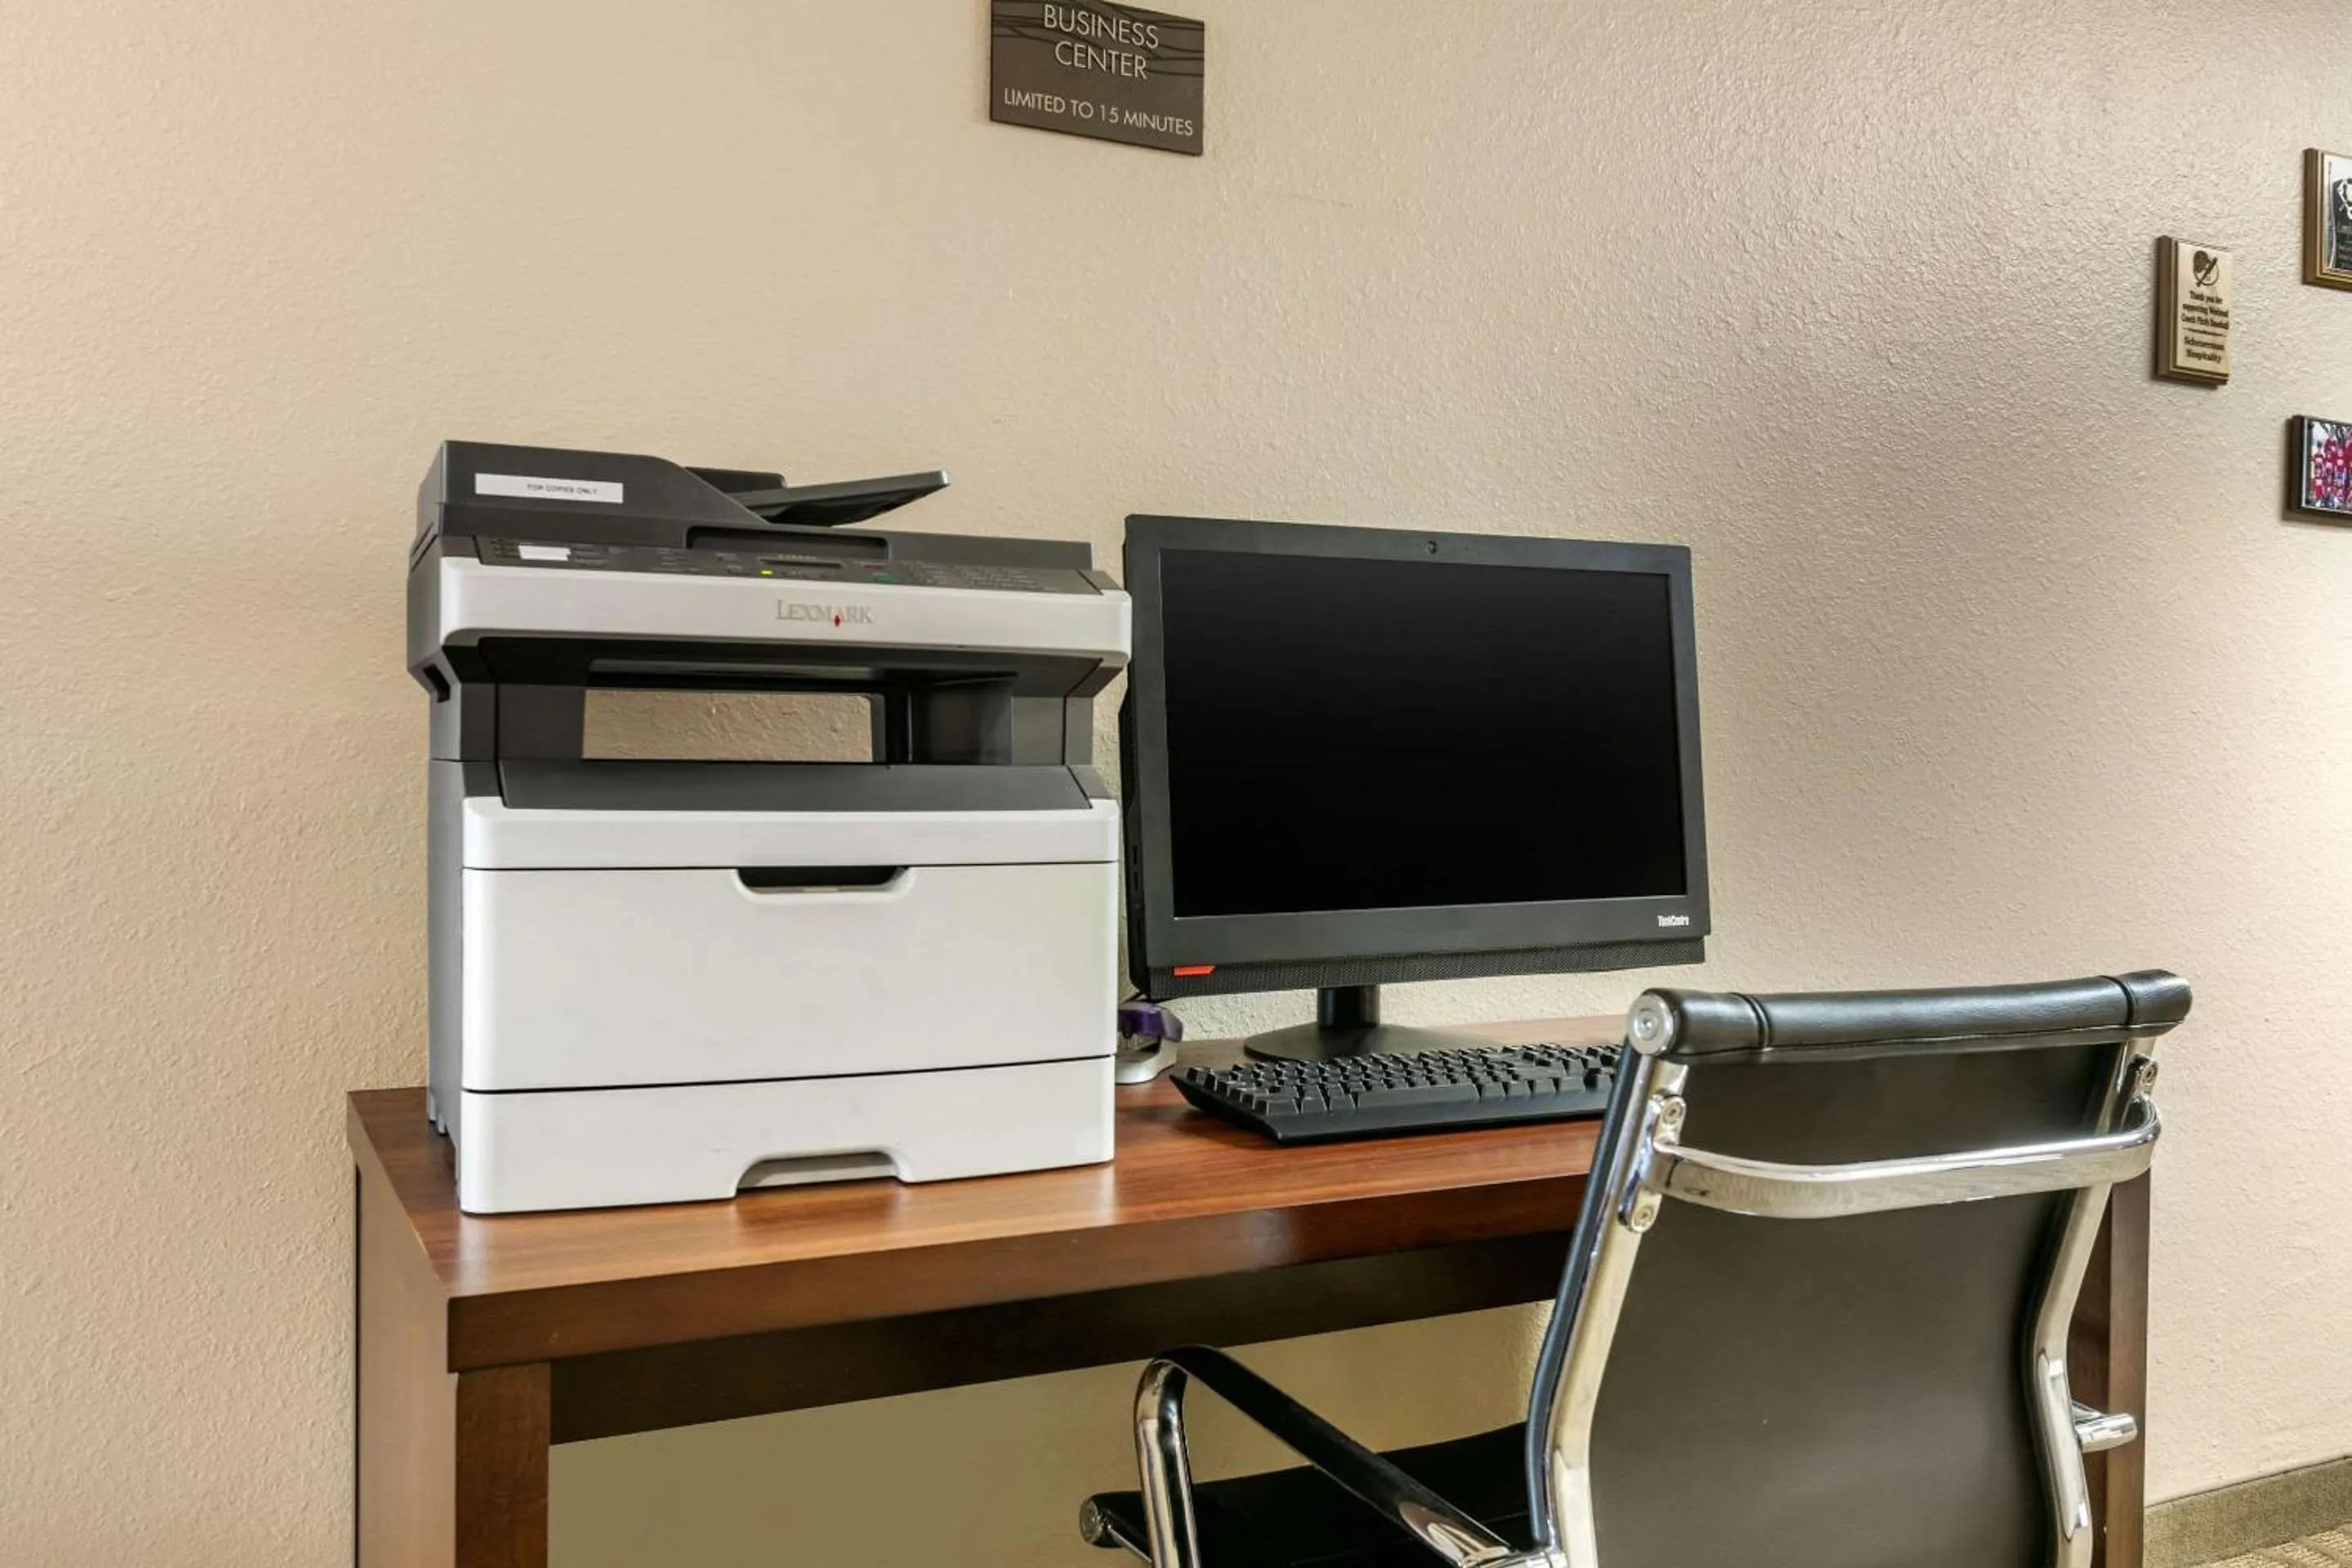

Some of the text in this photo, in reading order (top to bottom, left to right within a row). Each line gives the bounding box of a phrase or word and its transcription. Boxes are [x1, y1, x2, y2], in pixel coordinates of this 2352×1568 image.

[1044, 4, 1159, 49] BUSINESS
[1054, 41, 1147, 79] CENTER
[1004, 88, 1194, 136] LIMITED TO 15 MINUTES
[546, 484, 575, 493] COPIES
[577, 487, 597, 495] ONLY
